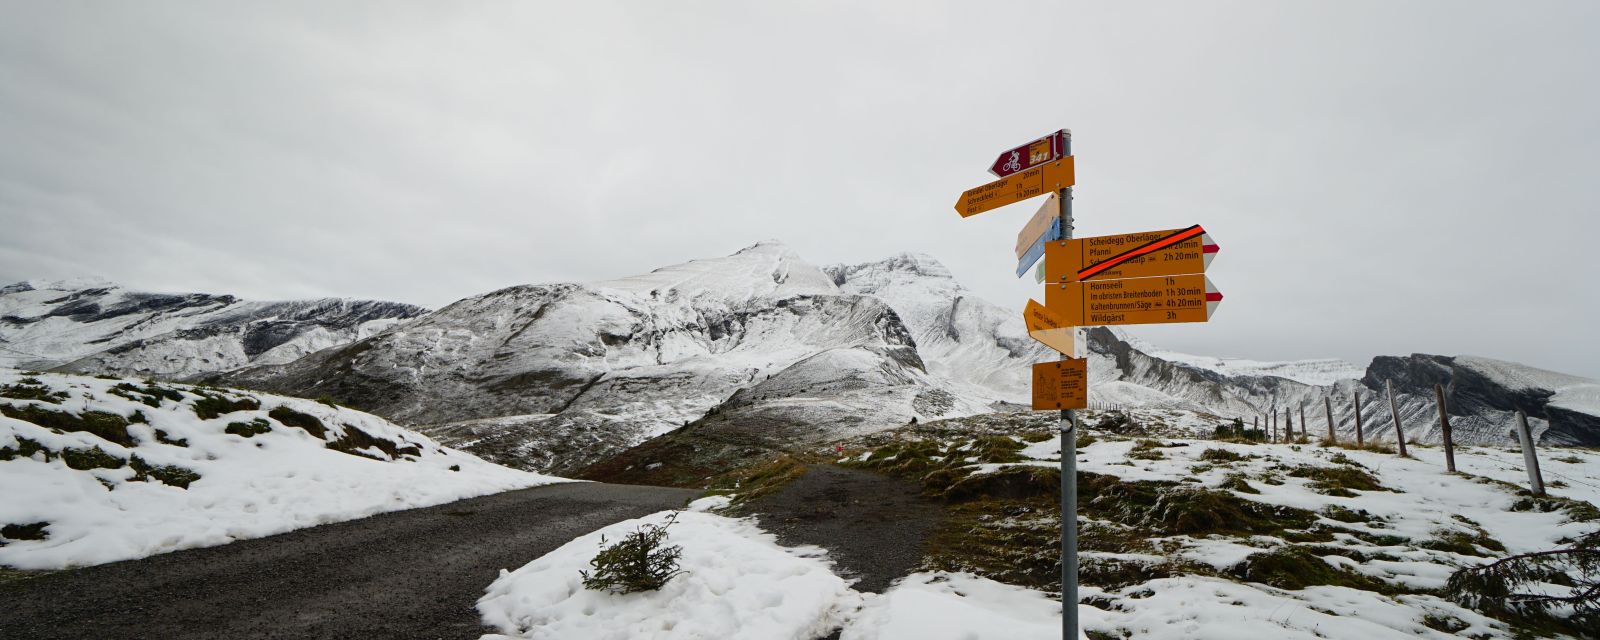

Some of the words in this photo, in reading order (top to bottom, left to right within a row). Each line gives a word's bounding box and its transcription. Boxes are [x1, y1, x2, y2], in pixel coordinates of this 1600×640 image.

[1029, 151, 1049, 164] 341
[1090, 236, 1125, 246] Scheidegg
[1125, 233, 1161, 243] Oberläger
[1090, 247, 1111, 256] Pfanni
[1164, 253, 1174, 261] 2h
[1175, 251, 1199, 260] 20min
[1090, 281, 1123, 290] Hornseeli
[1166, 278, 1175, 286] 1h
[1099, 291, 1123, 300] obristen
[1123, 289, 1163, 299] Breitenboden
[1166, 288, 1176, 296] 1h
[1177, 287, 1201, 296] 30min
[1091, 301, 1152, 311] Kaltenbrunnen/Säge
[1166, 299, 1176, 307] 4h
[1177, 298, 1202, 307] 20min
[1091, 313, 1124, 323] Wildgärst
[1167, 312, 1177, 320] 3h
